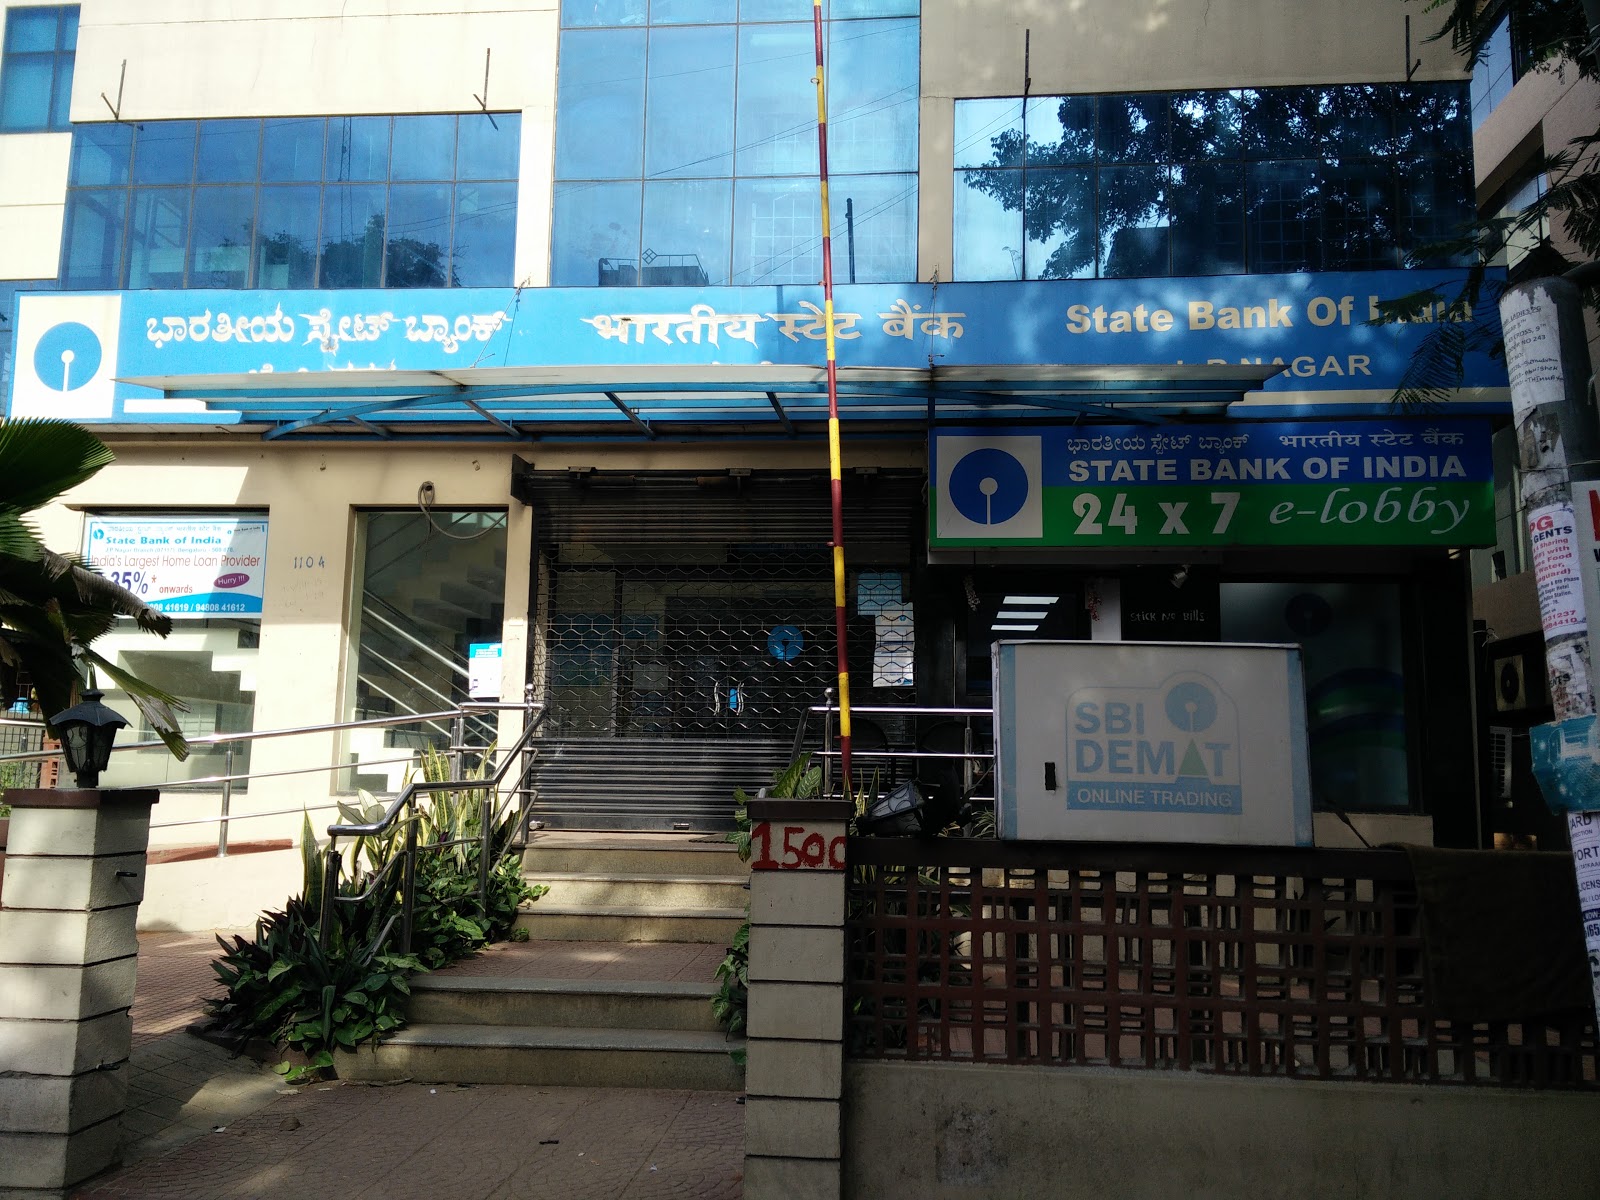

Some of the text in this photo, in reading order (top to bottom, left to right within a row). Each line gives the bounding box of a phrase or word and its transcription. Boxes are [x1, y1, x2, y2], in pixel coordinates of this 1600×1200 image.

[580, 298, 966, 349] भारतीय स्टेट बैंक
[1066, 304, 1174, 334] State
[1188, 299, 1293, 331] Bank
[1307, 296, 1354, 327] Of
[147, 302, 512, 356] ಭಾರತೀಯ ಸ್ಟೇಟ್ ಬ್ಯಾಂಕ್
[1067, 433, 1250, 455] ಭಾರತೀಯ ಸ್ಟೇಟ್ ಬ್ಯಾಂಕ್
[1279, 427, 1465, 448] भारतीय स्टेट बैंक
[1068, 455, 1467, 482] STATE BANK OF INDIA
[1071, 492, 1139, 535] 24
[1210, 491, 1241, 535] 7
[1269, 486, 1470, 535] e-lobby
[105, 536, 222, 545] State Bank of India
[1533, 525, 1573, 544] GENTS
[1547, 546, 1570, 554] with
[1547, 552, 1573, 562] Food
[91, 554, 261, 569] India's Largest Home Loan Provider
[159, 585, 193, 594] onwards
[217, 576, 236, 586] Hurry
[164, 603, 189, 612] 41619
[195, 603, 219, 612] 94808
[221, 603, 245, 612] 41612
[1543, 609, 1577, 625] 131237
[1075, 702, 1145, 735] SBI
[1076, 738, 1232, 776] DEMAT
[1077, 788, 1233, 807] ONLINE TRADING
[1570, 814, 1592, 828] ARD
